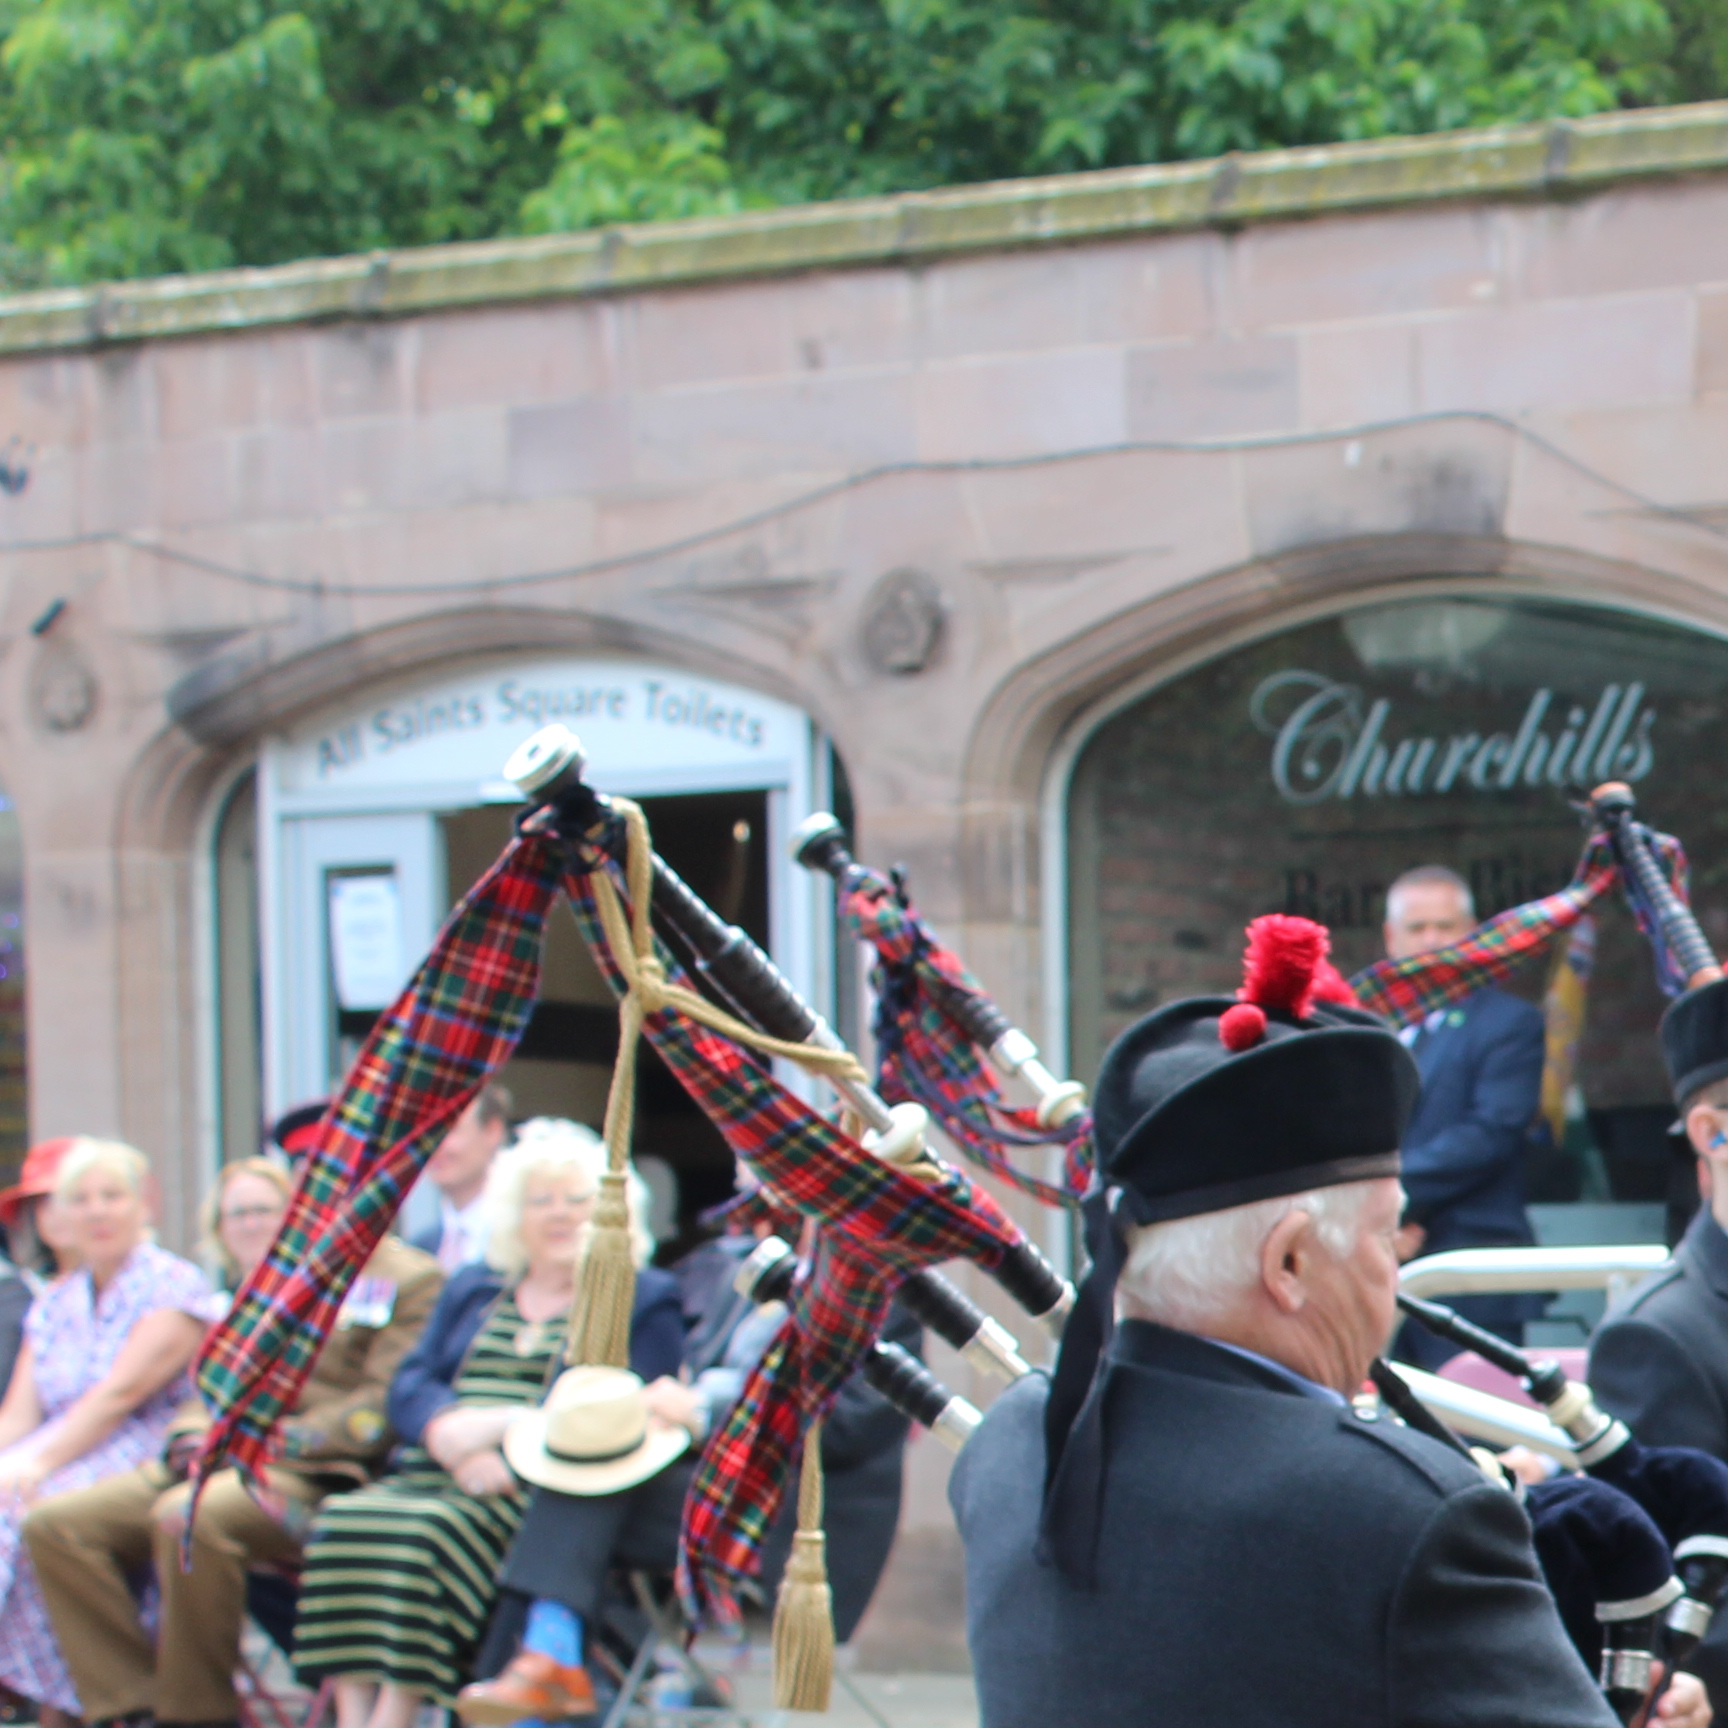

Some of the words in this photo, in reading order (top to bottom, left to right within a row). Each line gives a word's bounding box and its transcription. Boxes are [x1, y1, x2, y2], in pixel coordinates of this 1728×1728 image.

[316, 724, 364, 778] All
[371, 696, 484, 752] Saints
[496, 678, 626, 729] Square
[643, 679, 767, 747] Toilets
[1248, 668, 1658, 804] Churchills
